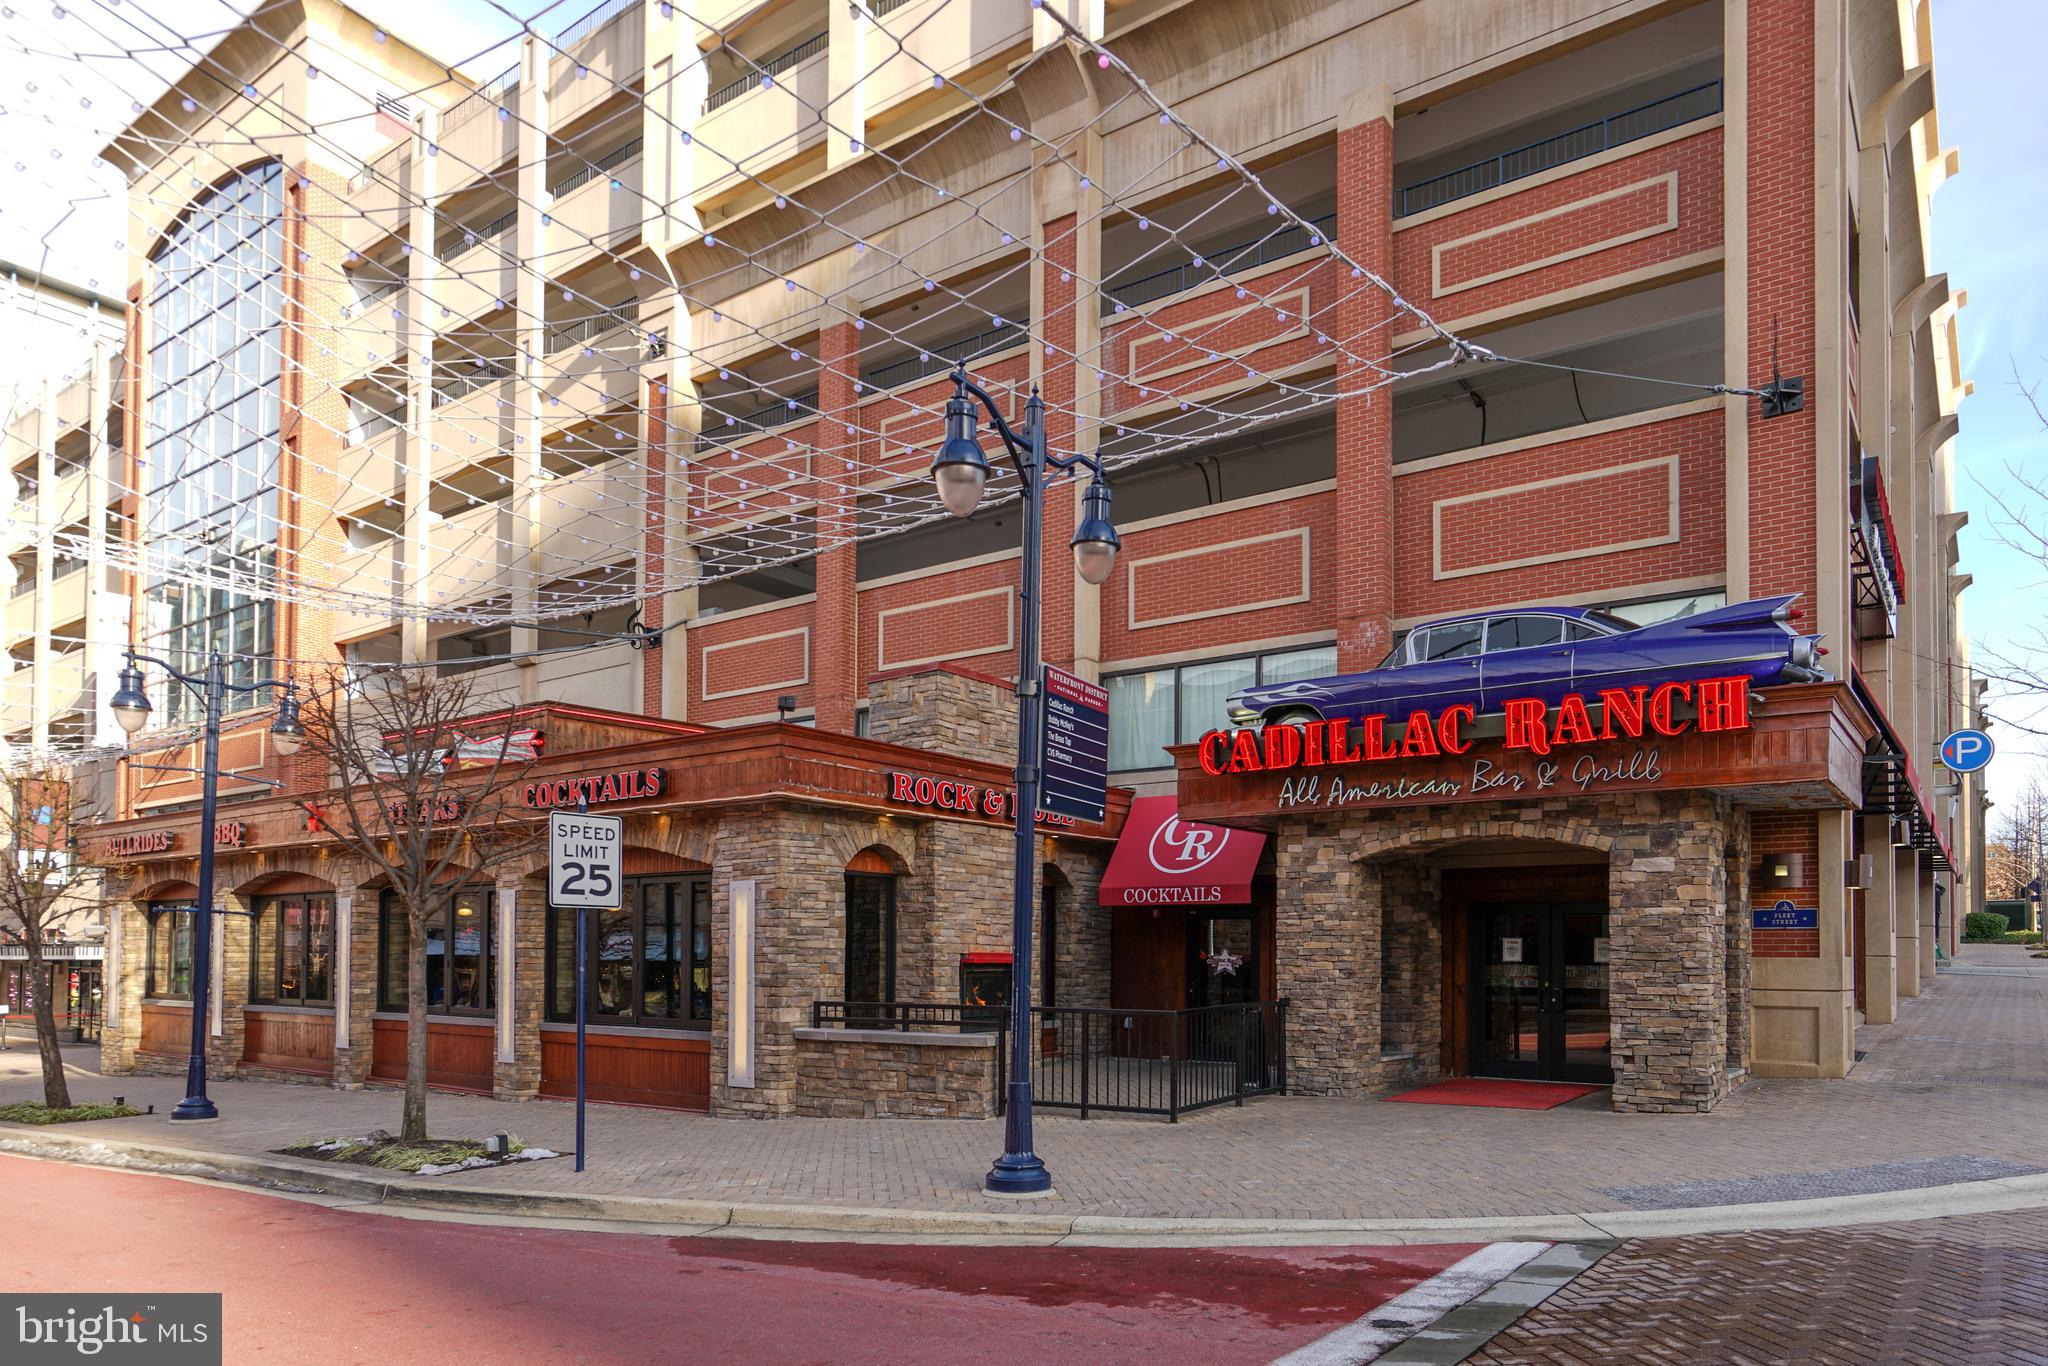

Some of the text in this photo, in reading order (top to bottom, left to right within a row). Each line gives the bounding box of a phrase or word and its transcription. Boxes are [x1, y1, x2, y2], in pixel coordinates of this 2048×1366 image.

[1048, 670, 1108, 702] WATERFRONT DISTRICT
[1048, 698, 1075, 715] Cadillac Ranch
[1048, 714, 1060, 727] Bobby
[1199, 674, 1753, 776] CADILLAC RANCH
[1047, 730, 1055, 741] The
[1046, 747, 1073, 764] CVS Pharmacy
[1956, 736, 1983, 765] P
[521, 767, 662, 810] COCKTAILS
[1278, 751, 1663, 808] All American Bar & Grill
[892, 772, 976, 812] ROCK
[983, 788, 1004, 815] &
[386, 794, 460, 826] STAKS
[105, 831, 170, 857] BULLRIDES
[214, 822, 243, 848] BBQ
[558, 824, 615, 841] SPEED
[564, 844, 609, 860] LIMIT
[560, 862, 612, 897] 25
[1123, 886, 1221, 904] COCKTAILS
